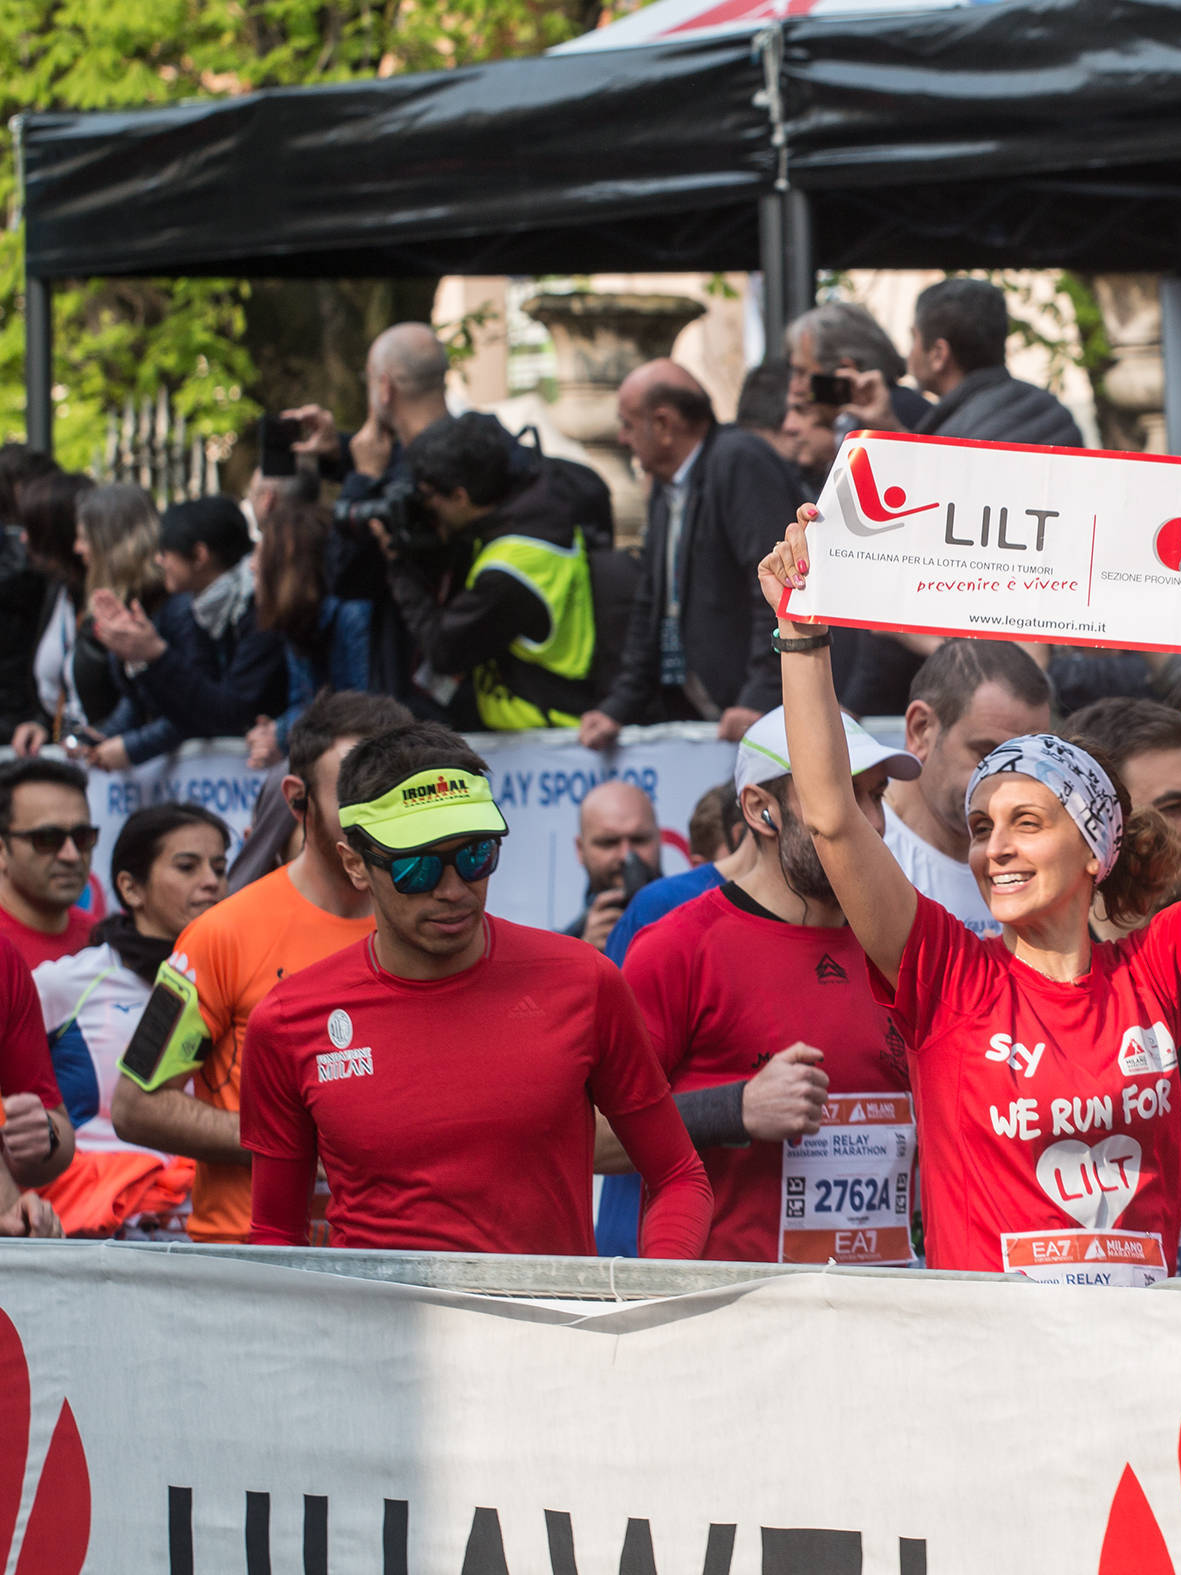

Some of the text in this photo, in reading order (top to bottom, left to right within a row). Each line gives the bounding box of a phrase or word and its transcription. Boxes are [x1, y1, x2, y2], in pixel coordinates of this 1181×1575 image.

[945, 502, 1060, 551] LILT
[829, 548, 855, 559] LEGA
[856, 551, 900, 563] ITALIANA
[902, 555, 920, 566] PER
[922, 556, 935, 567] LA
[937, 558, 967, 569] LOTTA
[970, 560, 1009, 572] CONTRO
[1017, 564, 1054, 576] TUMORI
[917, 576, 1079, 593] prevenire è vivere
[1100, 571, 1142, 583] SEZIONE
[968, 614, 1107, 633] www.legatumori.mi.it
[318, 1057, 374, 1083] MILAN
[990, 1078, 1172, 1140] WE RUN FOR
[832, 1134, 870, 1147] RELAY
[832, 1145, 888, 1157] MARATHON
[1053, 1155, 1134, 1203] LILT
[814, 1177, 892, 1213] 2762A
[835, 1230, 879, 1255] EA7
[1032, 1239, 1071, 1258] EA7
[1106, 1239, 1144, 1251] MILANO
[1065, 1273, 1112, 1286] RELAY
